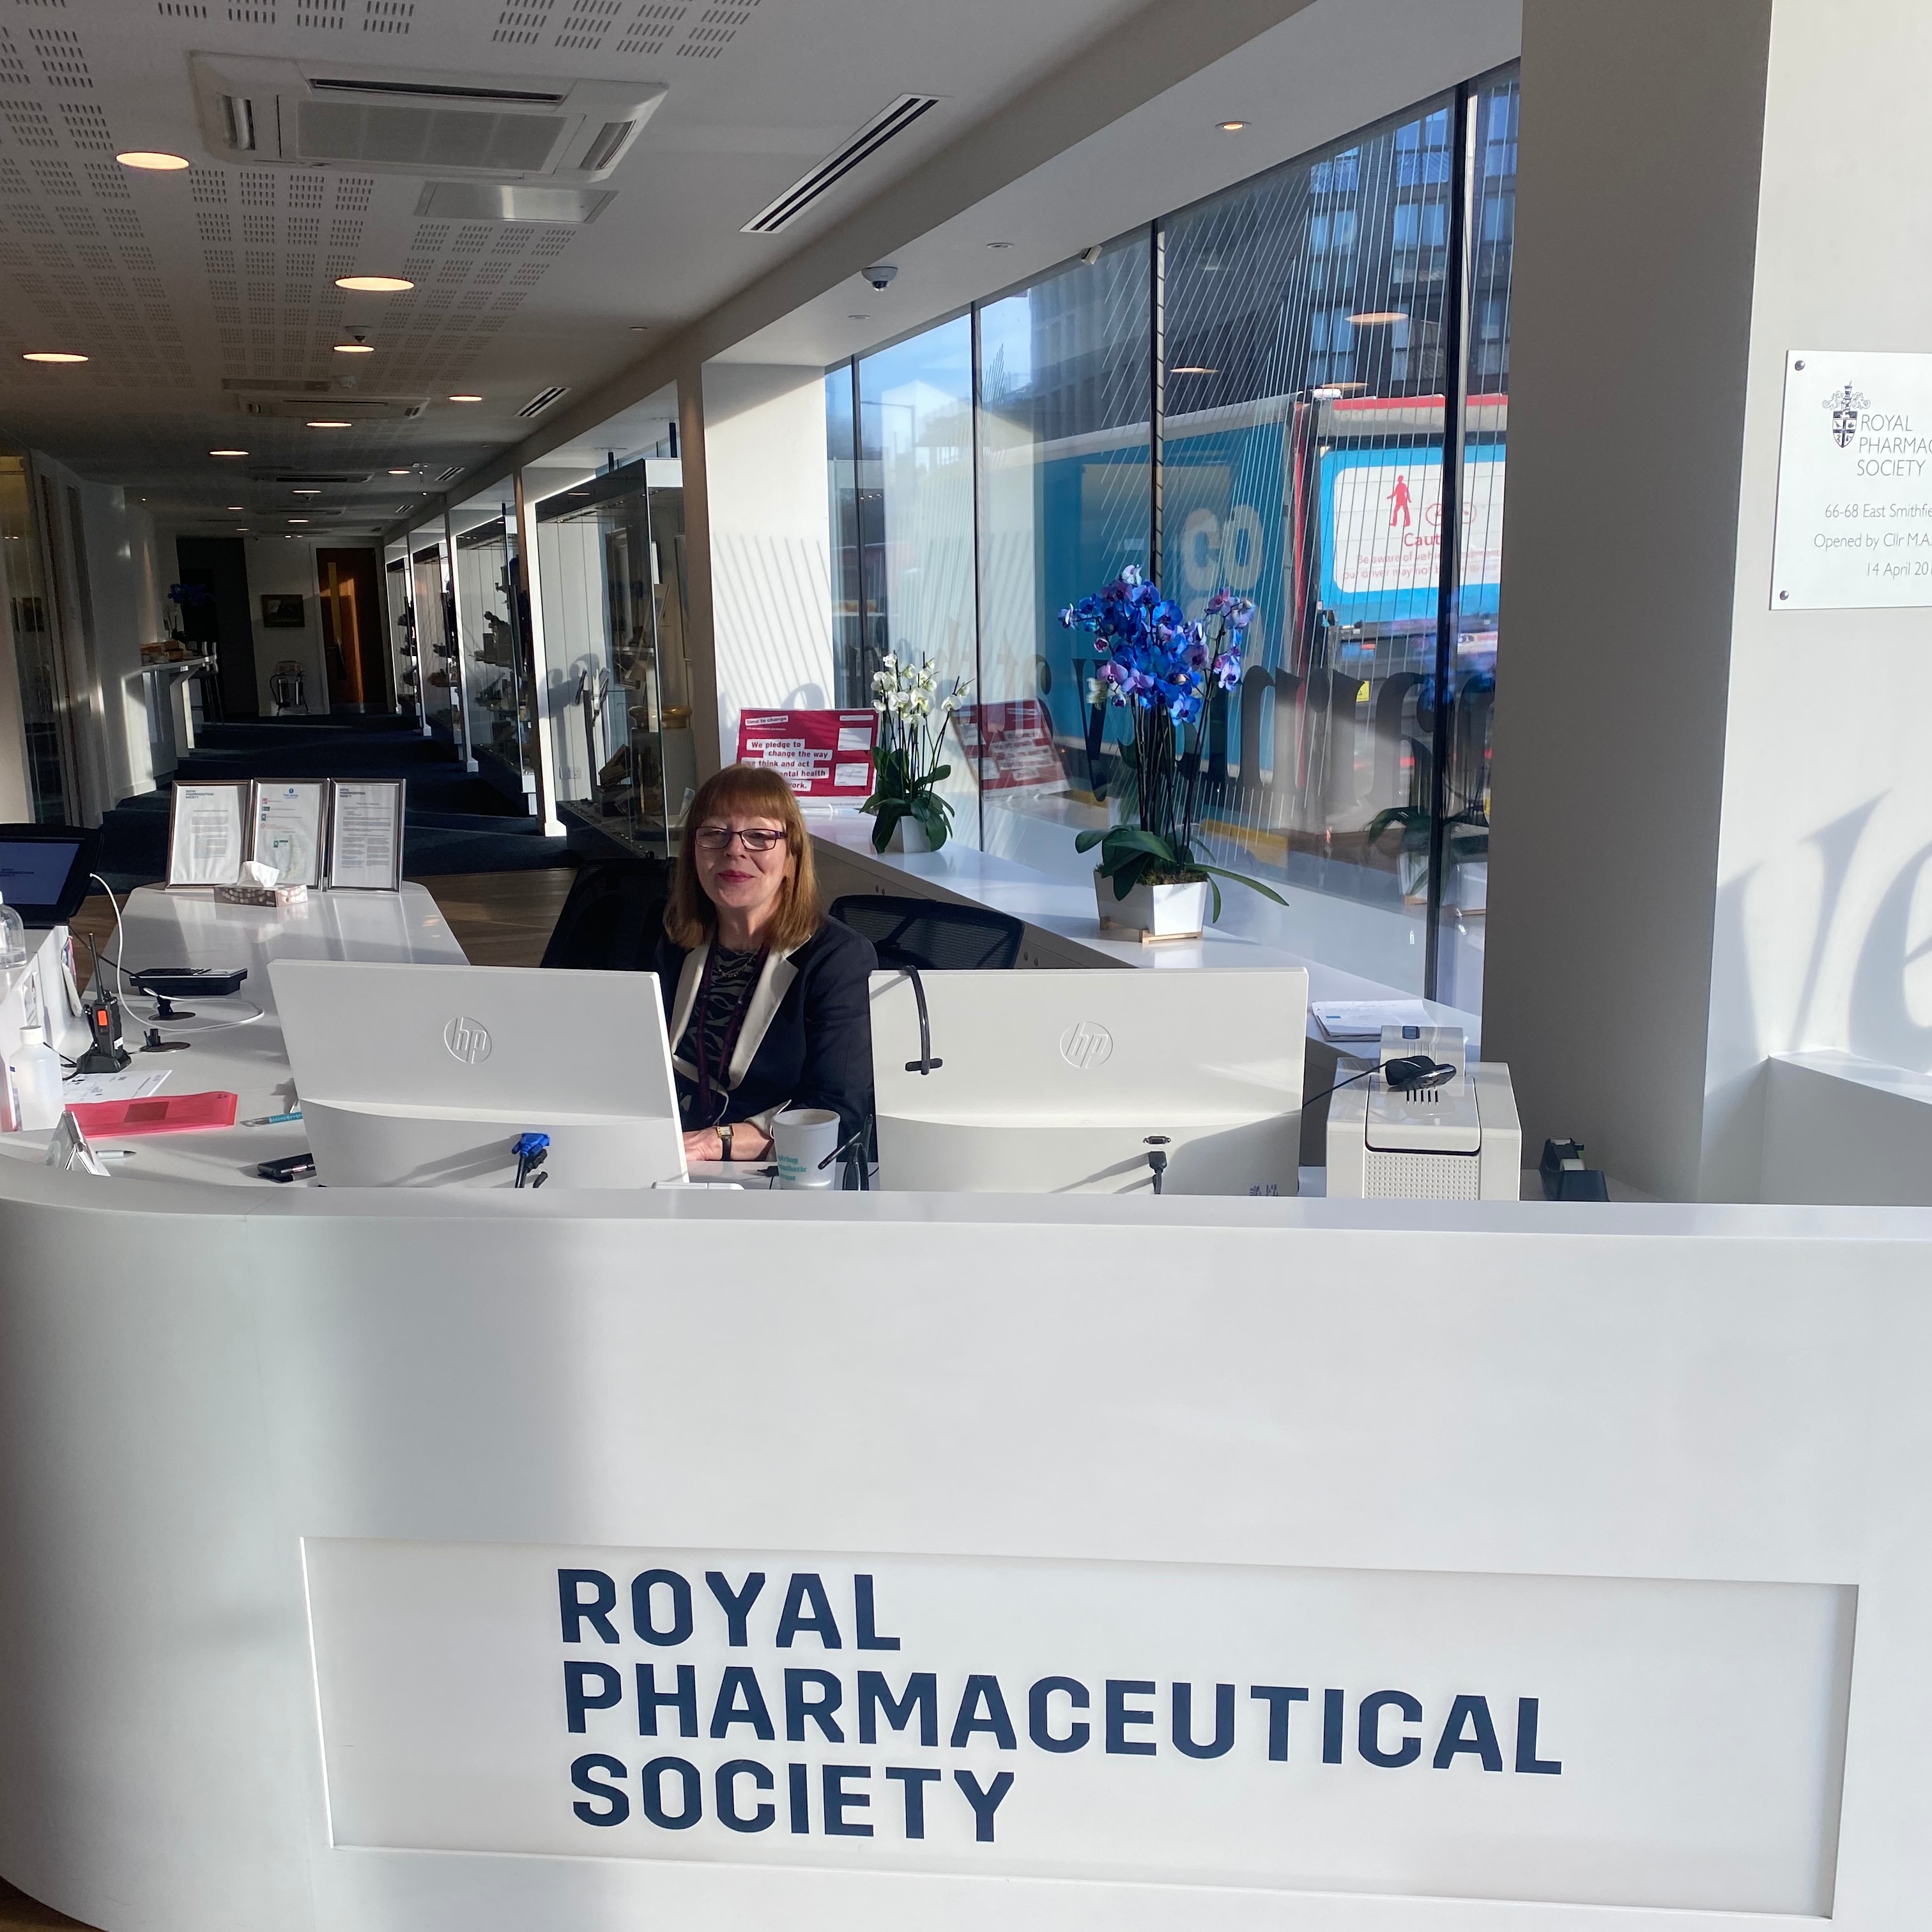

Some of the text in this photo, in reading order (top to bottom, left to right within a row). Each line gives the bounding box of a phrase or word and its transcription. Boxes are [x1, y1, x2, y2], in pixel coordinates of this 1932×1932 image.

[1860, 414, 1913, 431] ROYAL
[1859, 437, 1932, 454] PHARMA
[1857, 459, 1926, 476] SOCIETY
[1825, 503, 1859, 518] 66-68
[1863, 503, 1885, 518] East
[1404, 532, 1441, 547] Caut
[1814, 533, 1862, 551] Opened
[1866, 533, 1880, 551] by
[1883, 533, 1905, 547] Cllr
[1867, 561, 1932, 580] 14 April 20
[765, 740, 791, 749] pledge
[793, 740, 801, 748] to
[768, 749, 795, 758] change
[798, 749, 811, 758] the
[801, 769, 825, 777] health
[450, 1016, 488, 1064] hp
[1065, 1021, 1109, 1069] hp
[557, 1568, 901, 1651] ROYAL
[564, 1660, 1562, 1775] PHARMACEUTICAL
[571, 1753, 1015, 1843] SOCIETY
